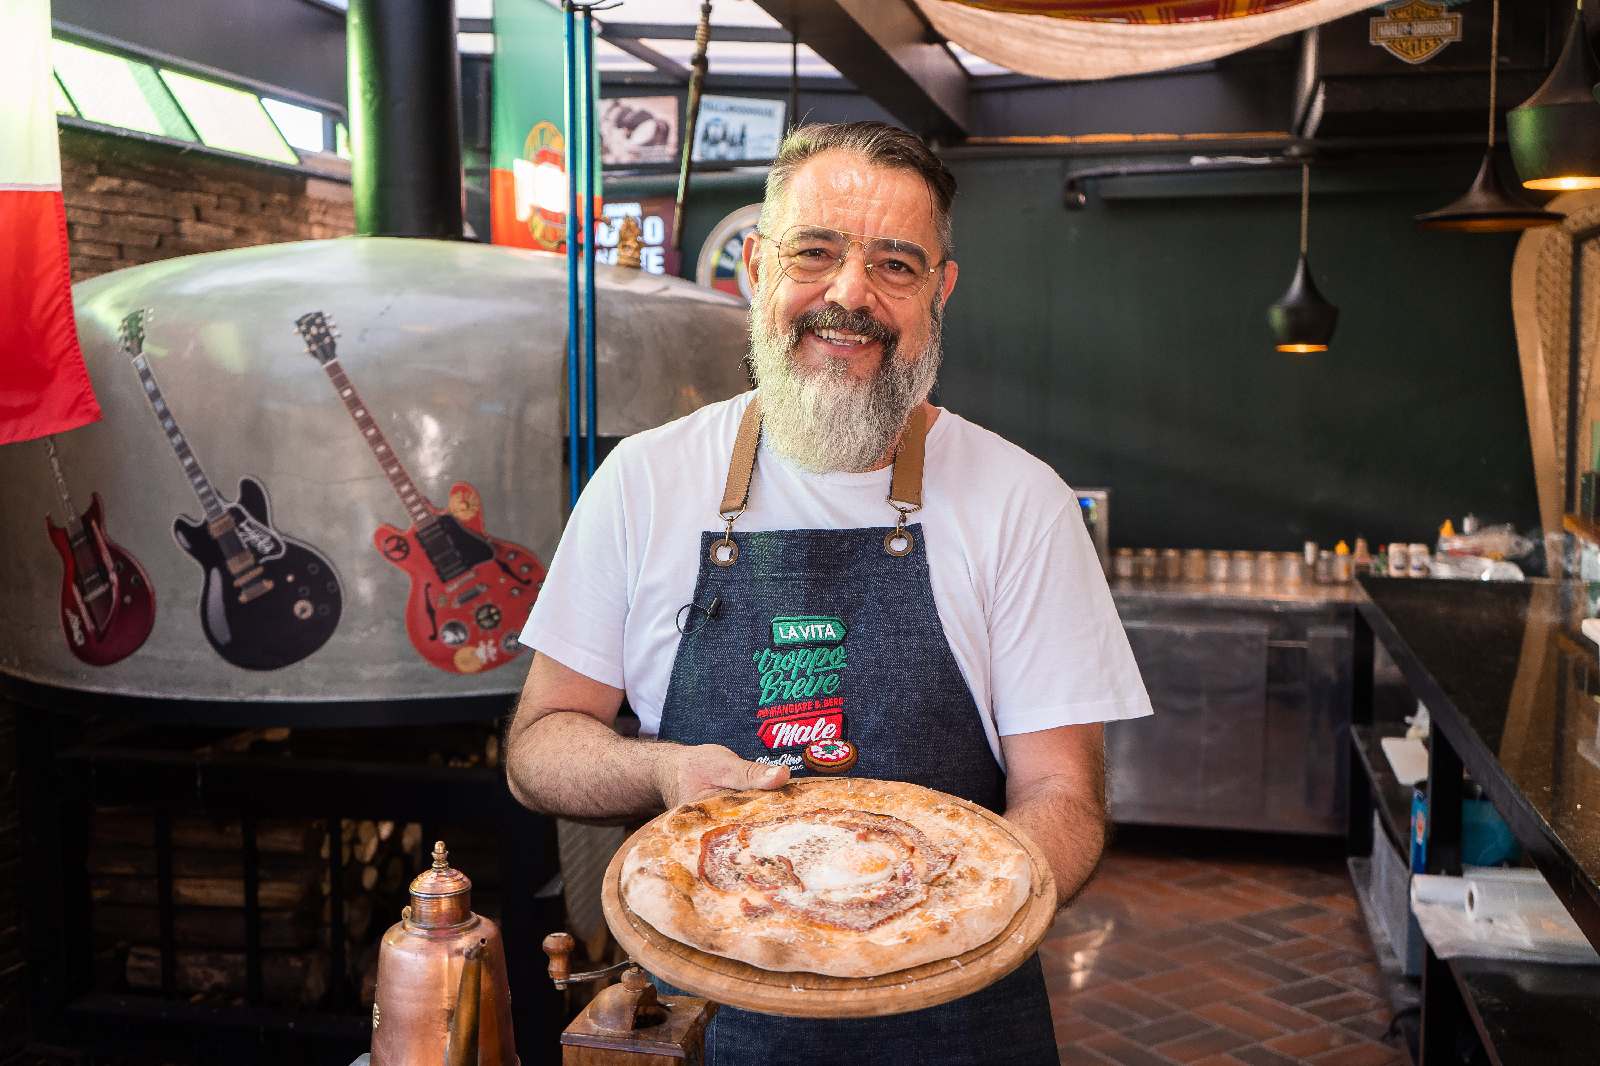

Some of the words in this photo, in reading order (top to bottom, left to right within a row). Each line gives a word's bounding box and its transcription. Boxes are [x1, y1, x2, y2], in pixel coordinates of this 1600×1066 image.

[779, 626, 799, 639] LA
[798, 624, 837, 638] VITA
[758, 646, 847, 680] troppo
[759, 669, 841, 705] Breve
[770, 701, 813, 717] MANGIARE
[814, 700, 822, 709] &
[823, 697, 844, 708] BERE
[772, 718, 837, 748] Male
